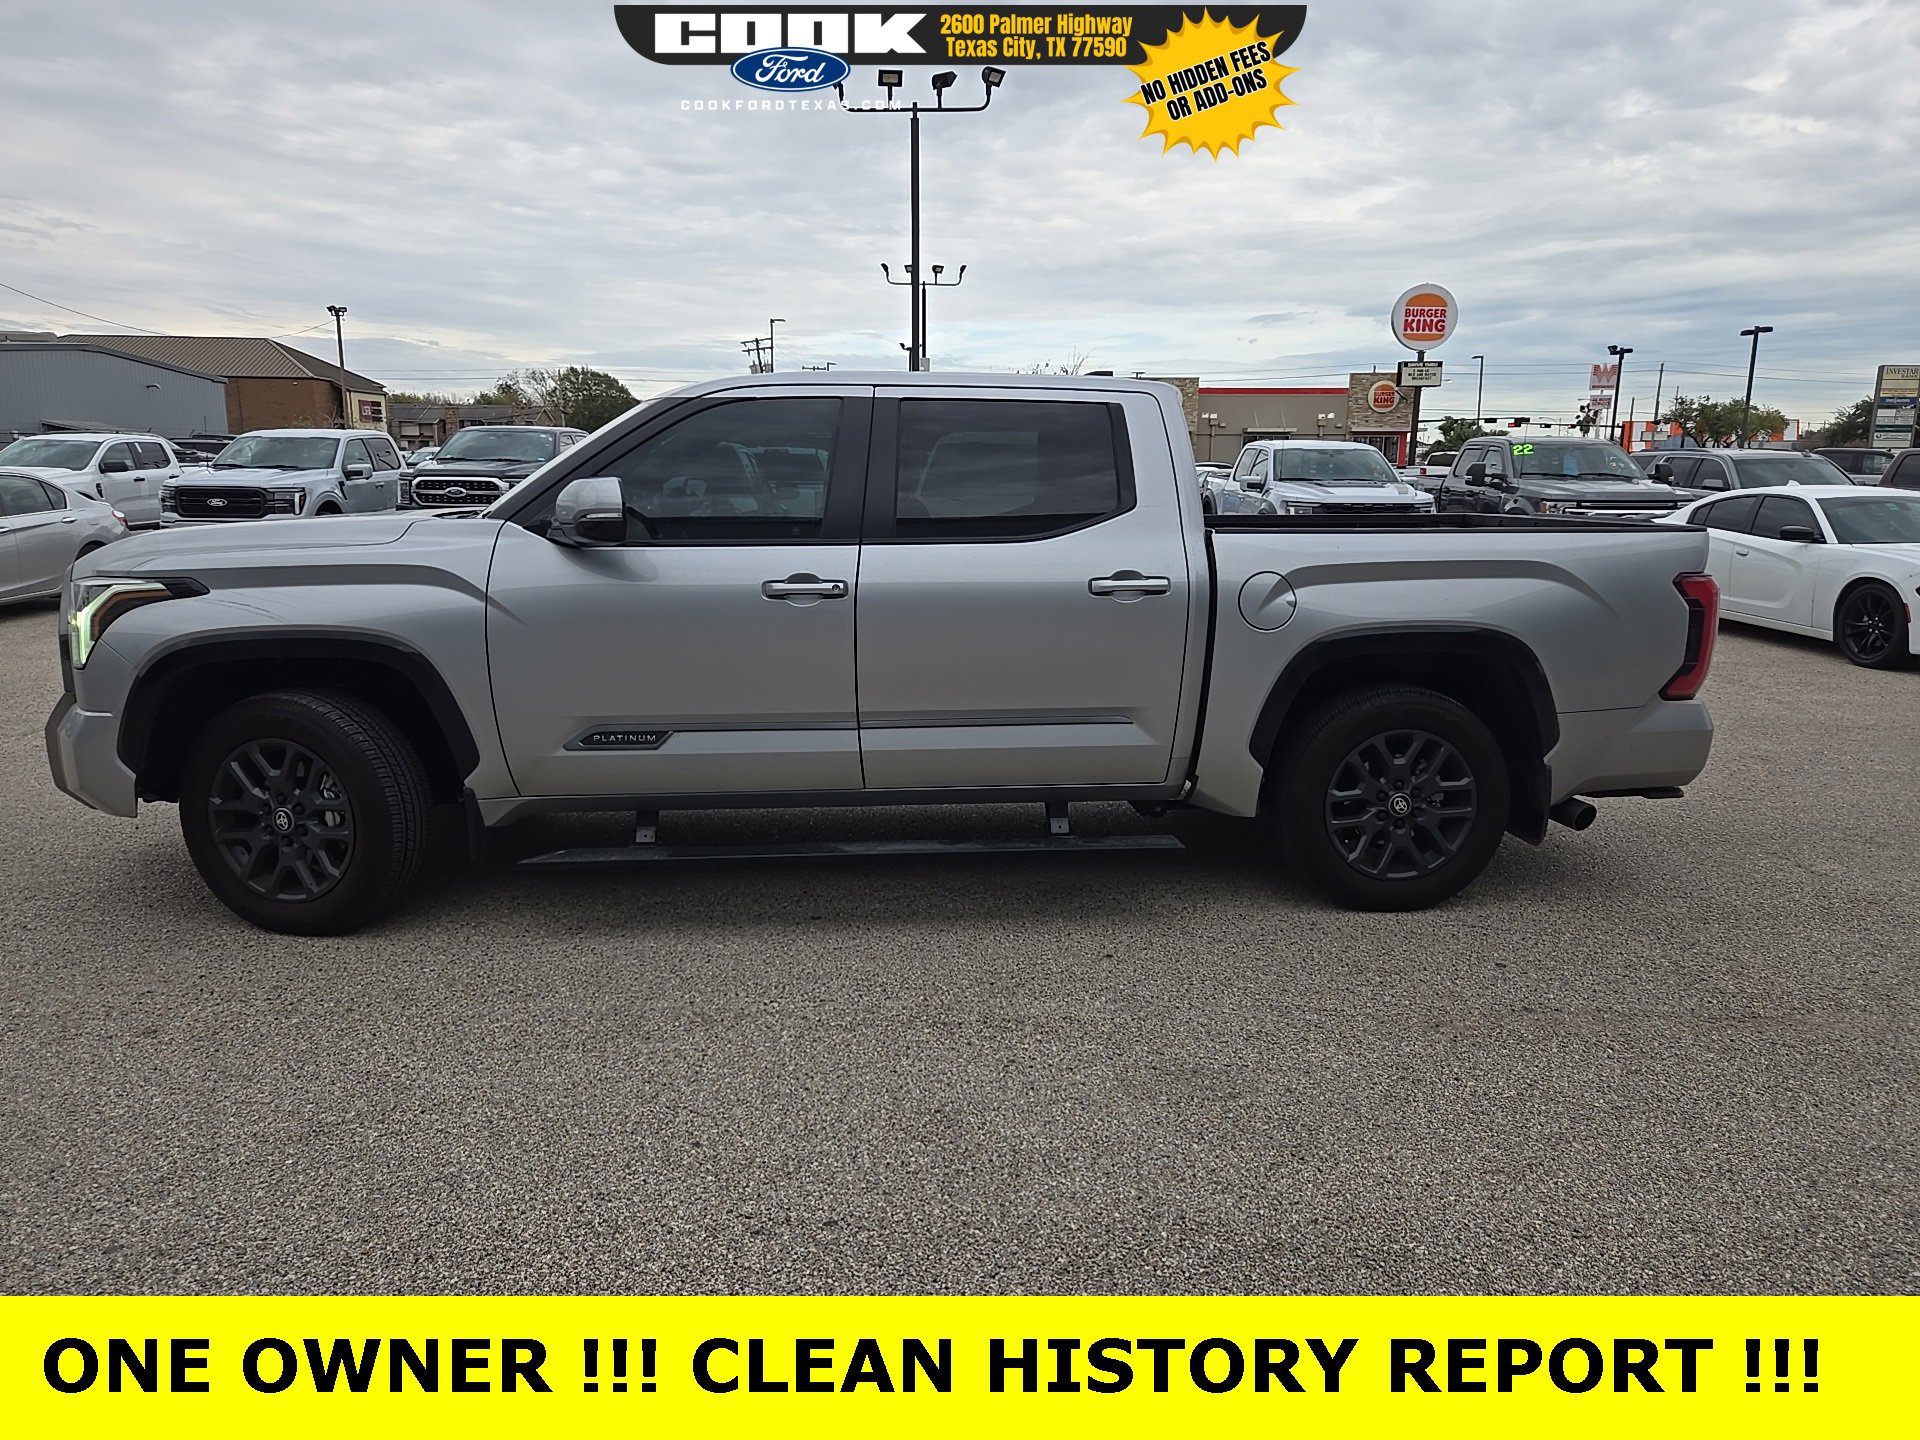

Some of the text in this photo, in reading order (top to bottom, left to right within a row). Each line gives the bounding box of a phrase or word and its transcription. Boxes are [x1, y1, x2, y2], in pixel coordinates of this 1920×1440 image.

[1404, 308, 1447, 319] BURGER
[1403, 319, 1446, 332] KING
[1886, 367, 1919, 375] INVESTAR
[1373, 396, 1395, 404] KING
[1512, 444, 1534, 455] 22
